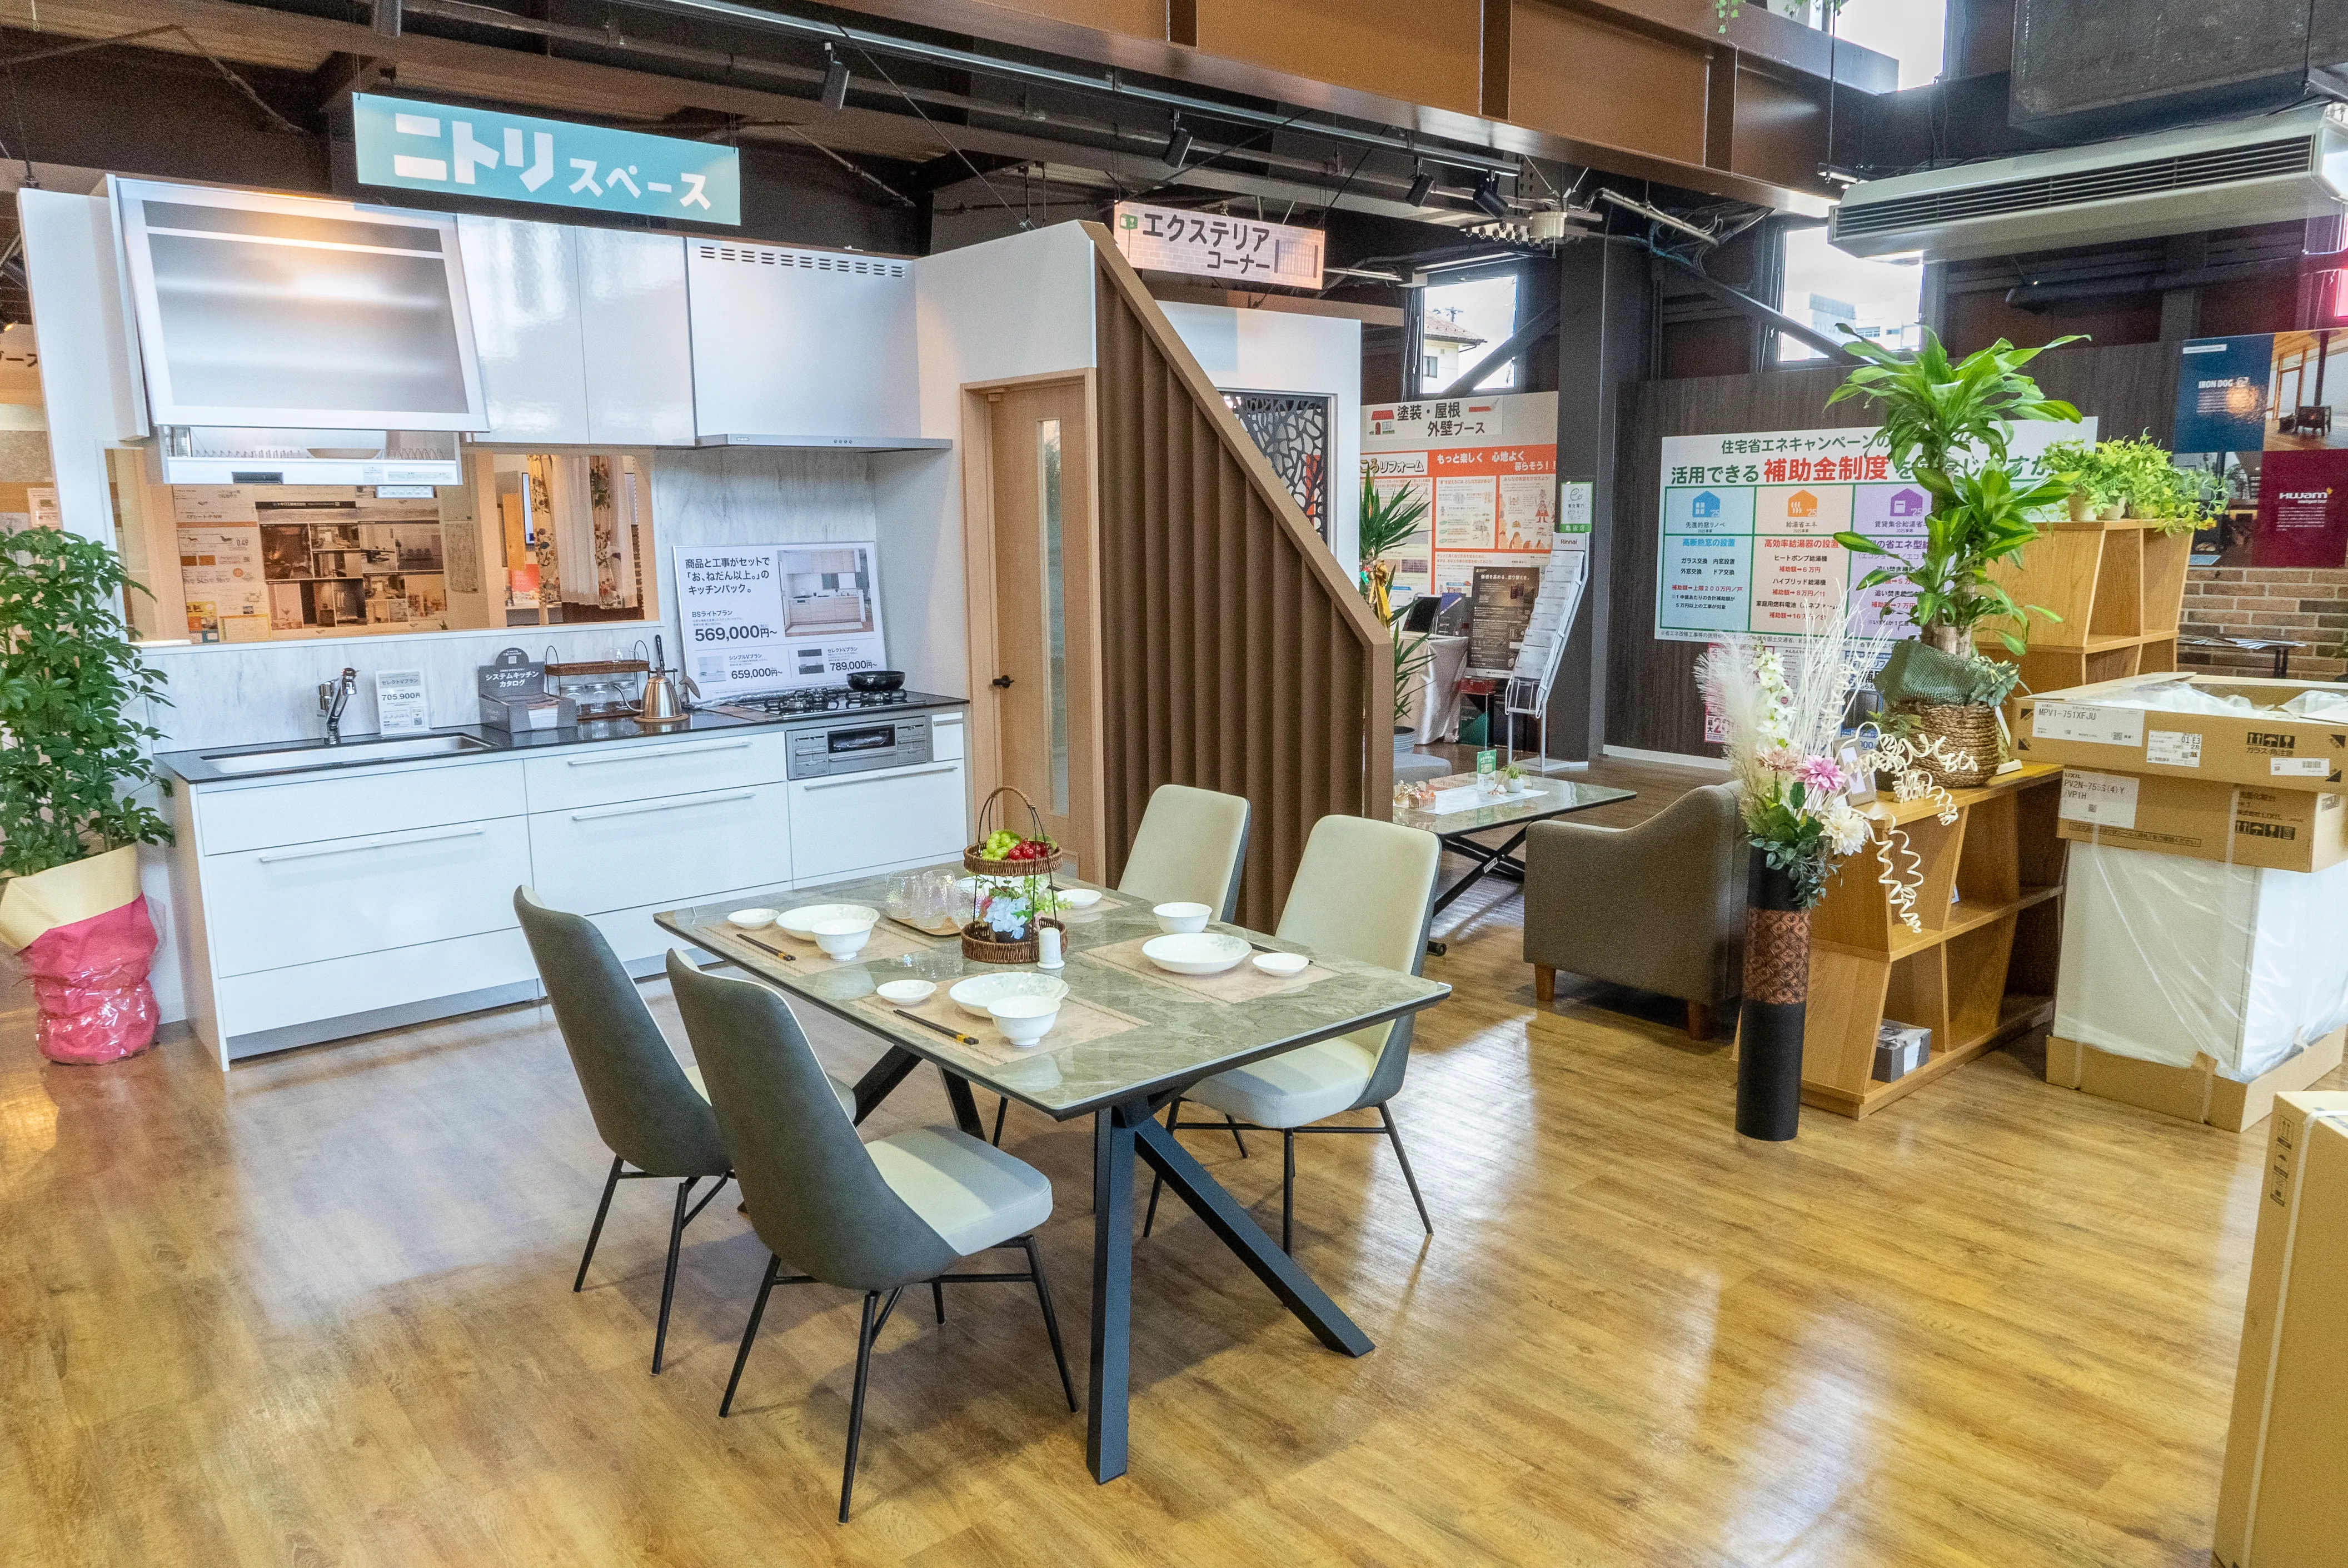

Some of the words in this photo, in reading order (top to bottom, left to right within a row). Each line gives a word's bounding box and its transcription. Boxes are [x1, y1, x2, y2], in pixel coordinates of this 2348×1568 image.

[393, 113, 554, 192] ニトリ
[569, 158, 711, 210] スペース
[1143, 213, 1270, 252] エクステリア
[1207, 251, 1270, 274] コーナー
[0, 350, 38, 367] ース
[2198, 379, 2217, 389] IRON
[2217, 379, 2234, 388] DOG
[1397, 402, 1461, 421] 塗装・屋根
[1427, 421, 1485, 438] 外壁ブース
[1436, 453, 1482, 465] もっと楽しく
[1491, 451, 1525, 463] 心地よく
[1671, 465, 1759, 485] 活用できる
[1764, 455, 1890, 482] 補助金制度
[1682, 538, 1736, 547] 高断熱窓の設置
[1764, 538, 1839, 548] 高効率給湯器の設置
[685, 556, 770, 570] 商品と工事がセットで
[687, 570, 770, 582] 「お、ねだん以上。」の
[688, 583, 751, 595] キッチンパック。
[486, 671, 540, 681] システムキッチン
[499, 679, 526, 688] カタログ
